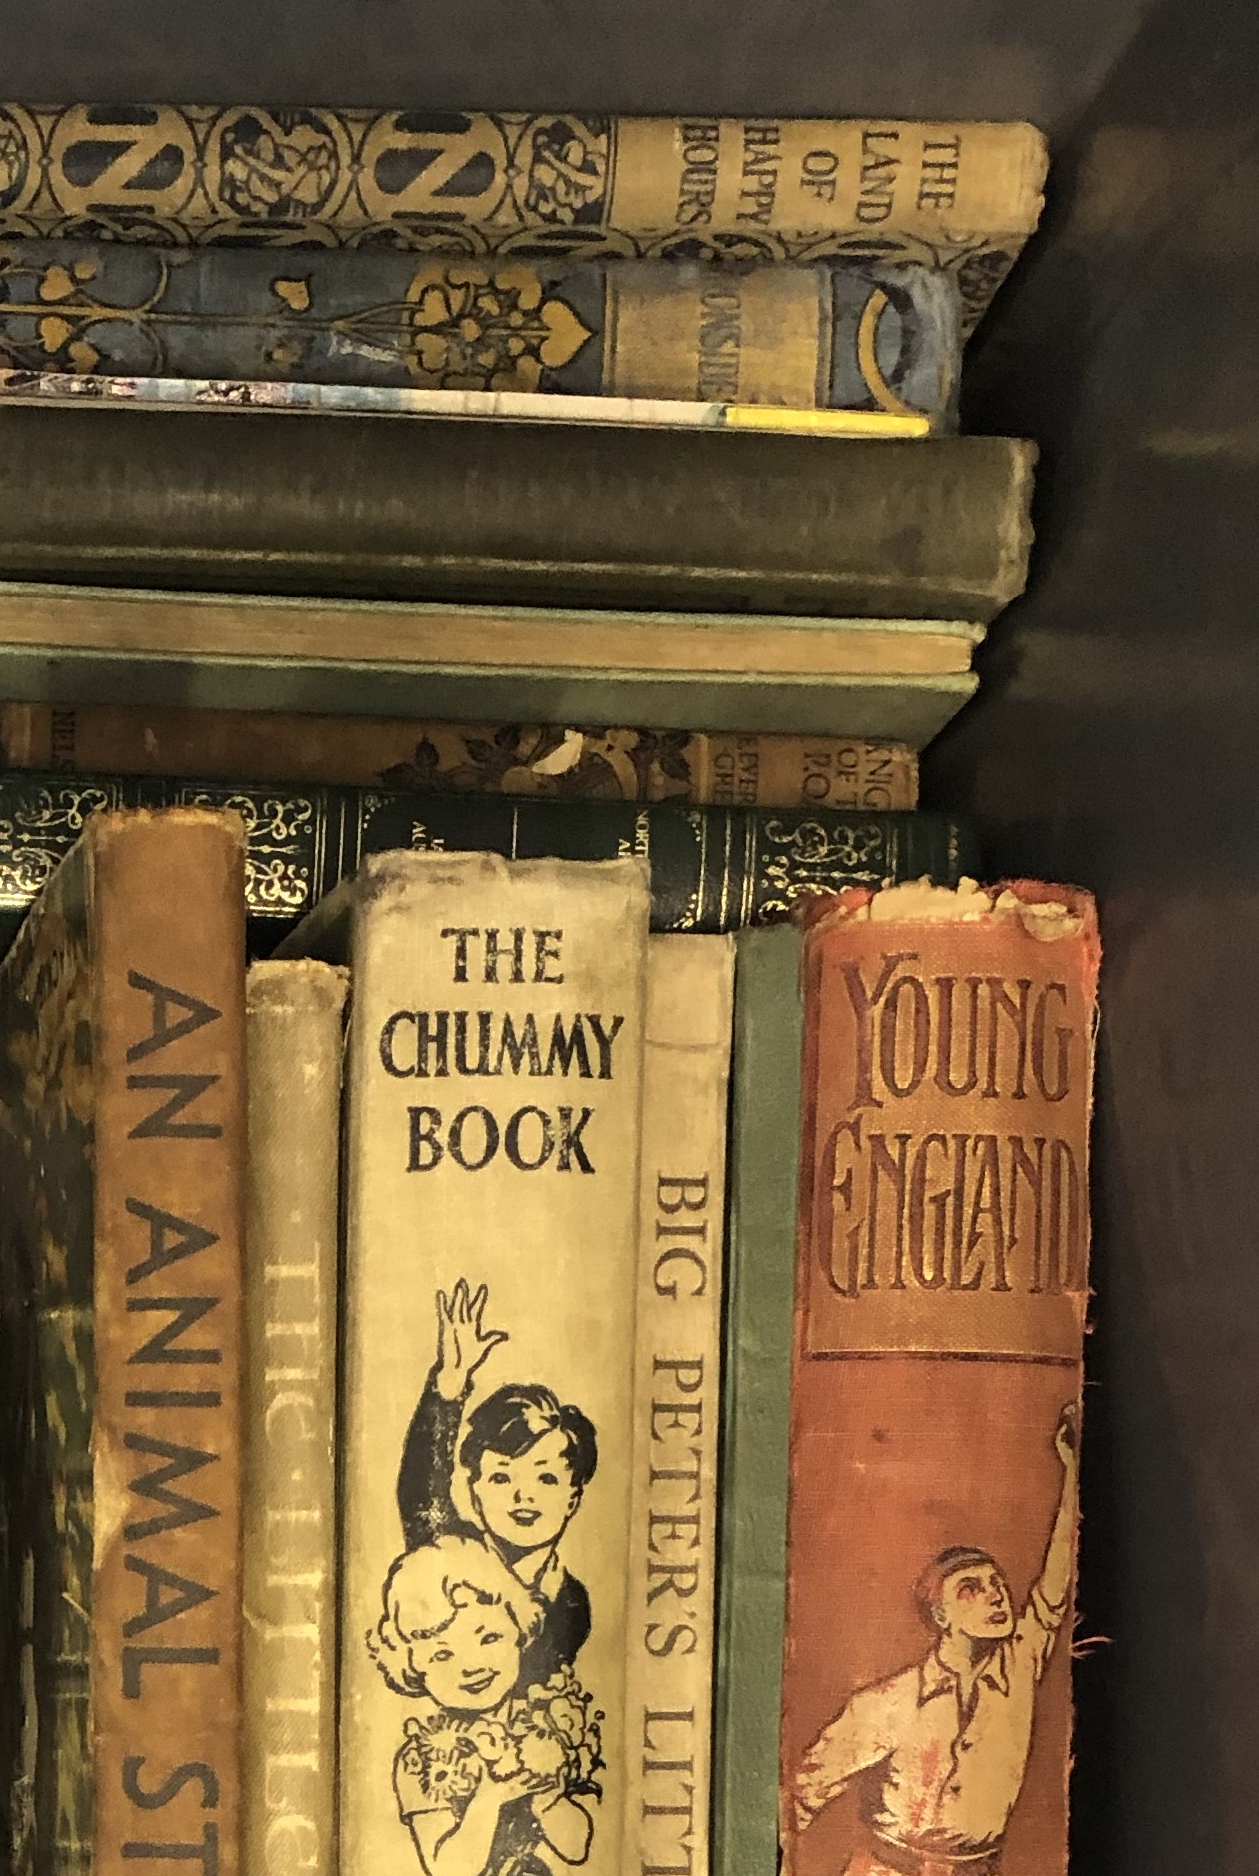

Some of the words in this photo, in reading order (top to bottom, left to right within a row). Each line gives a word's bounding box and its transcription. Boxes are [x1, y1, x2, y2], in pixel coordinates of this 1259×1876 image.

[677, 123, 720, 227] HOURS
[735, 125, 780, 227] HAPPY
[800, 149, 841, 203] OF
[856, 129, 901, 226] LAND
[916, 134, 962, 211] THE
[52, 710, 76, 770] NELS
[836, 748, 860, 784] OF
[440, 927, 564, 984] THE
[125, 966, 223, 1144] AN
[379, 1010, 625, 1080] CHUMMY
[839, 950, 1074, 1110] YOUNG
[406, 1104, 596, 1174] BOOK
[654, 1169, 710, 1300] BIG
[817, 1113, 1087, 1299] ENGLAND
[120, 1196, 220, 1700] ANIMAL
[640, 1352, 706, 1658] PETER'S
